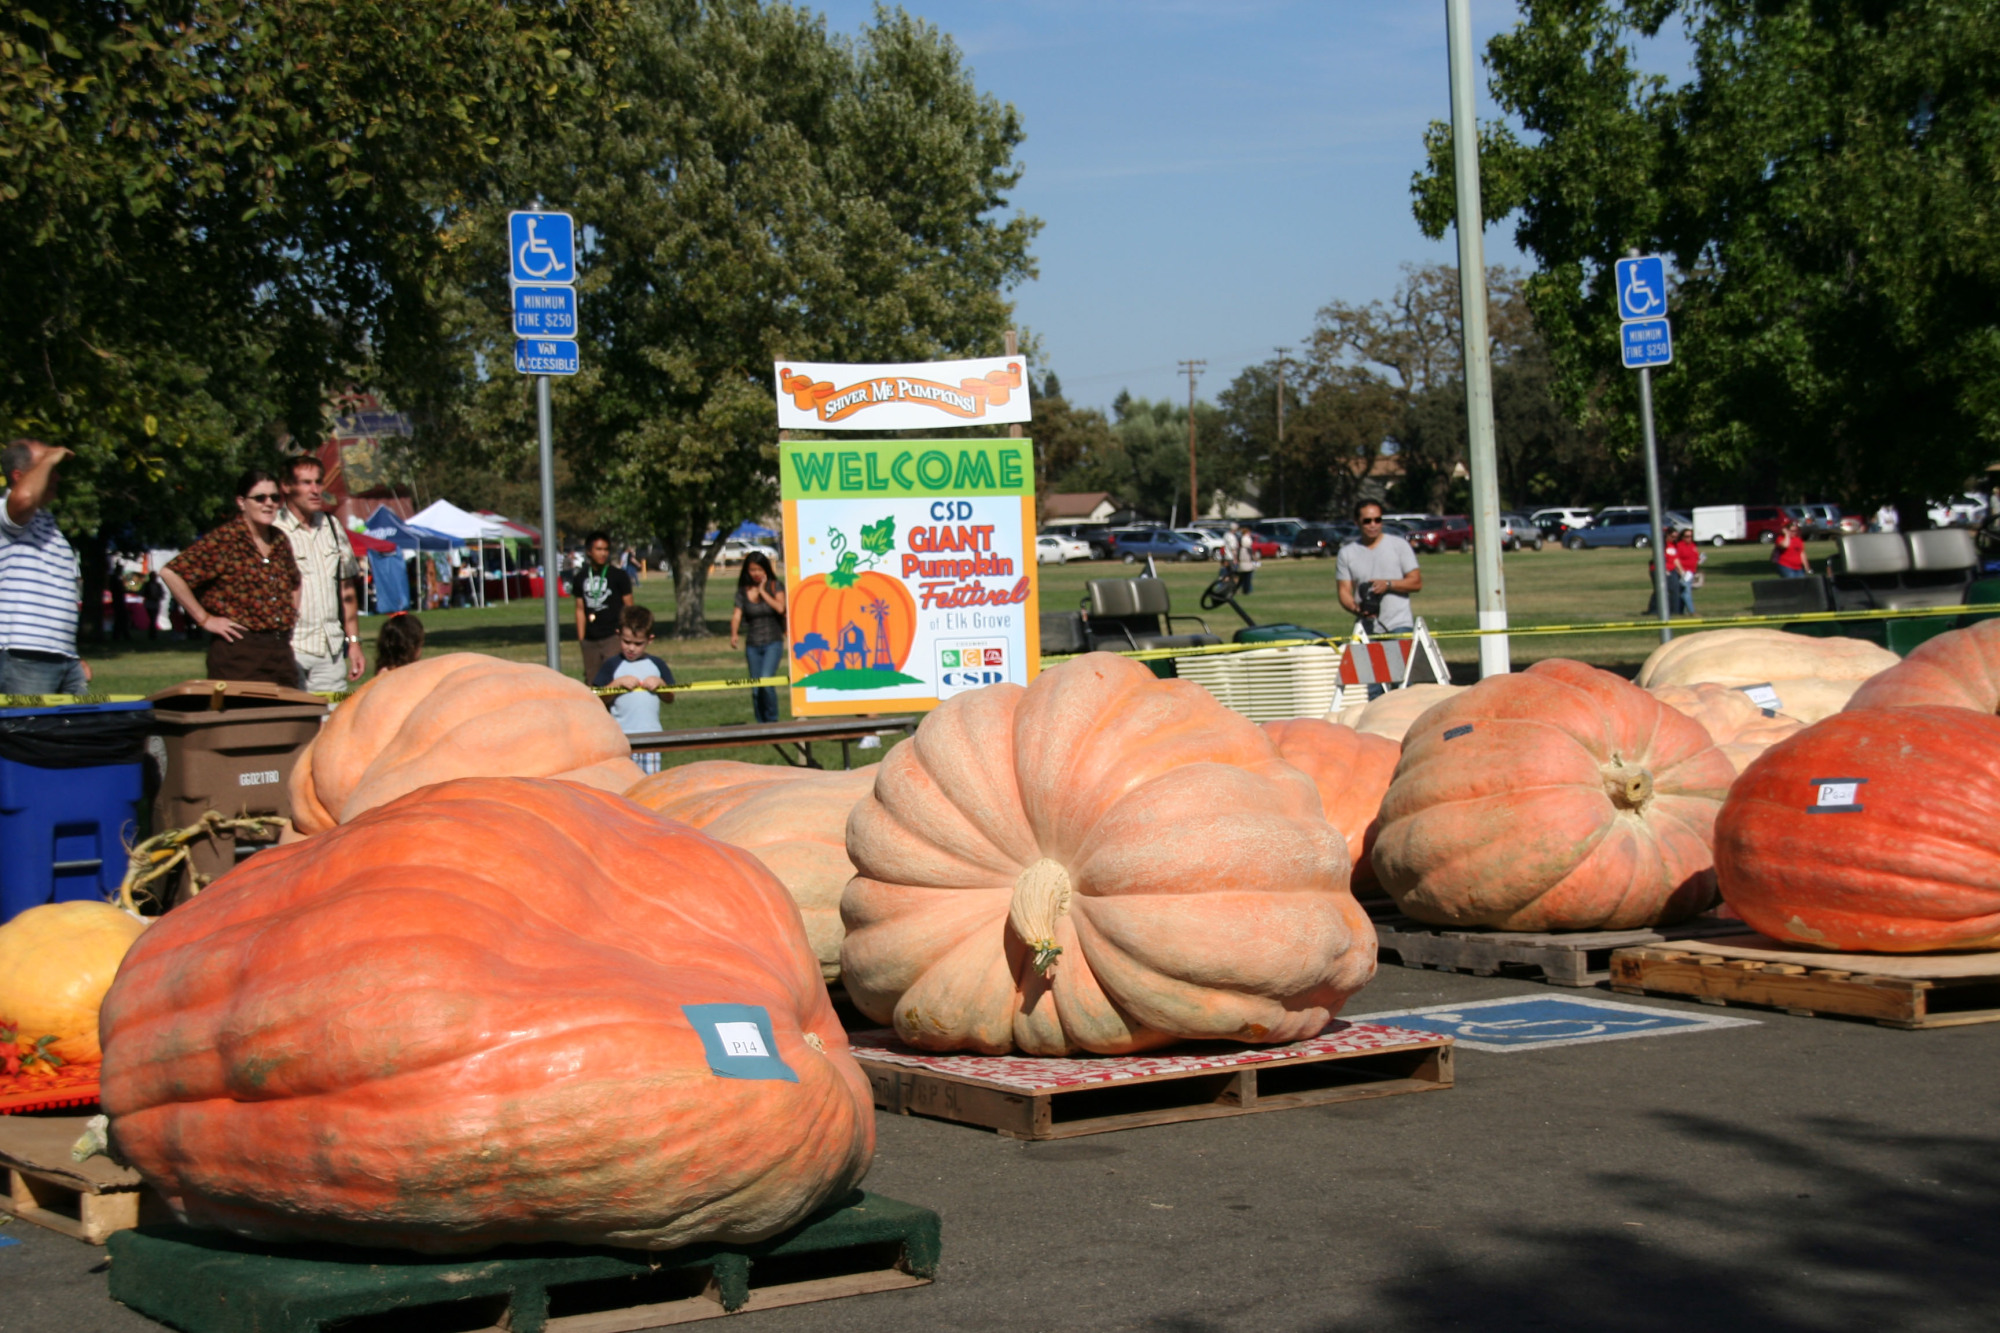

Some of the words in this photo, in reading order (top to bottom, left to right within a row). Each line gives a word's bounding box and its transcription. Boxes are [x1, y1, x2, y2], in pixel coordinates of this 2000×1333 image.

[523, 295, 566, 309] MINIMUM
[518, 312, 540, 327] FINE
[1629, 328, 1662, 343] MINIMUM
[537, 342, 557, 355] VAN
[1625, 345, 1643, 358] FINE
[825, 388, 869, 419] SHIVER
[790, 449, 1024, 492] WELCOME
[930, 501, 973, 521] CSD
[908, 525, 995, 552] GIANT
[901, 551, 1013, 582] Pumpkin
[918, 575, 1031, 610] Festival
[929, 617, 940, 631] of
[946, 612, 968, 630] Elk
[973, 611, 1011, 629] Grove
[942, 671, 1003, 686] CSD
[732, 1041, 758, 1054] P14
